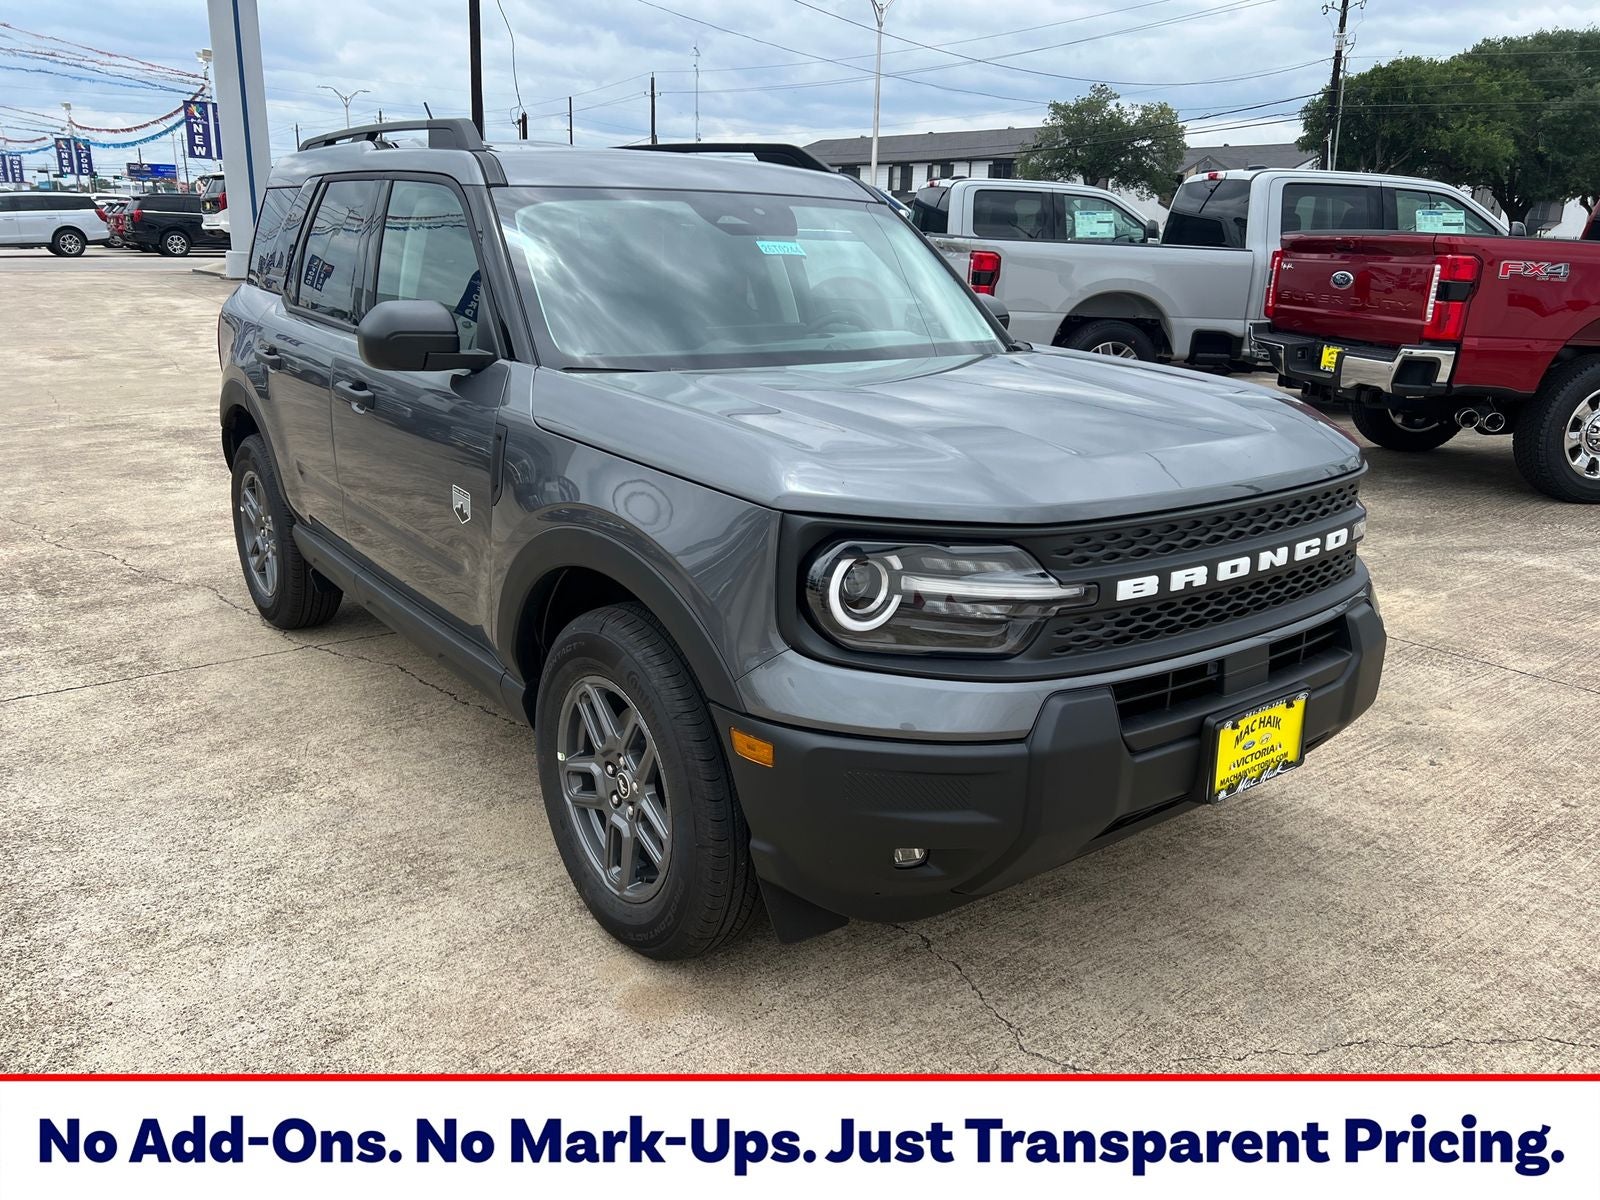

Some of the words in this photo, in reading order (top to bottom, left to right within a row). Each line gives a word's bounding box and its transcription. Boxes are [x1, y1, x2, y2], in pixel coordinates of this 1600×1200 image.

[193, 123, 206, 156] NEW
[61, 152, 71, 173] NEW
[80, 153, 89, 174] FORD
[1498, 260, 1570, 280] FX4
[1280, 290, 1344, 305] SUPER
[1349, 296, 1413, 311] DUTY
[1116, 527, 1349, 601] BRONCO
[1234, 718, 1257, 748] MAC
[1258, 715, 1282, 731] HAIK
[1236, 744, 1275, 768] VICTORIA
[1220, 751, 1289, 786] MACHAIKVICTORIA.COM
